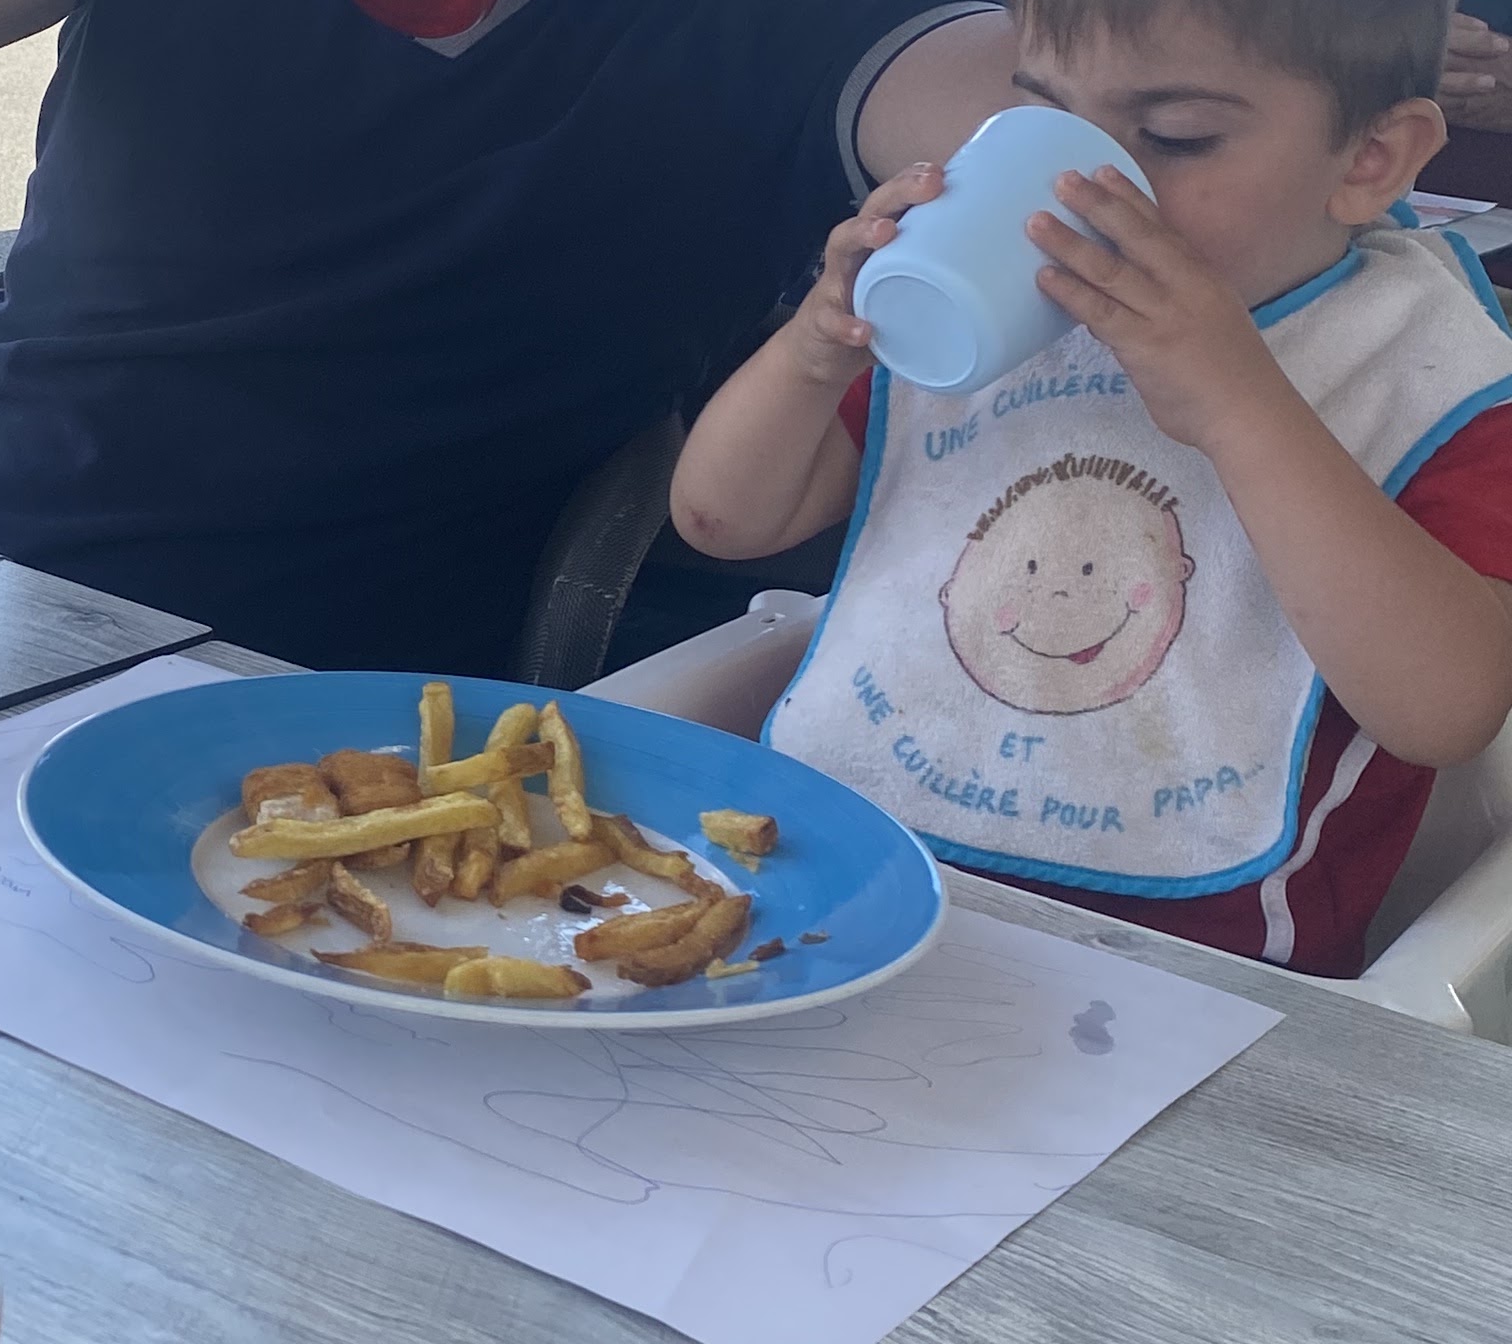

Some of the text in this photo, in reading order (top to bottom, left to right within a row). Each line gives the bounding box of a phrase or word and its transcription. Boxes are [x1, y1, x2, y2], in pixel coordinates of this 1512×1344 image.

[925, 363, 1130, 461] UNE CUILLÈRE
[852, 665, 896, 726] UNE
[892, 734, 1020, 818] CUILLÈRE
[1039, 795, 1126, 834] POUR
[999, 731, 1046, 761] ET
